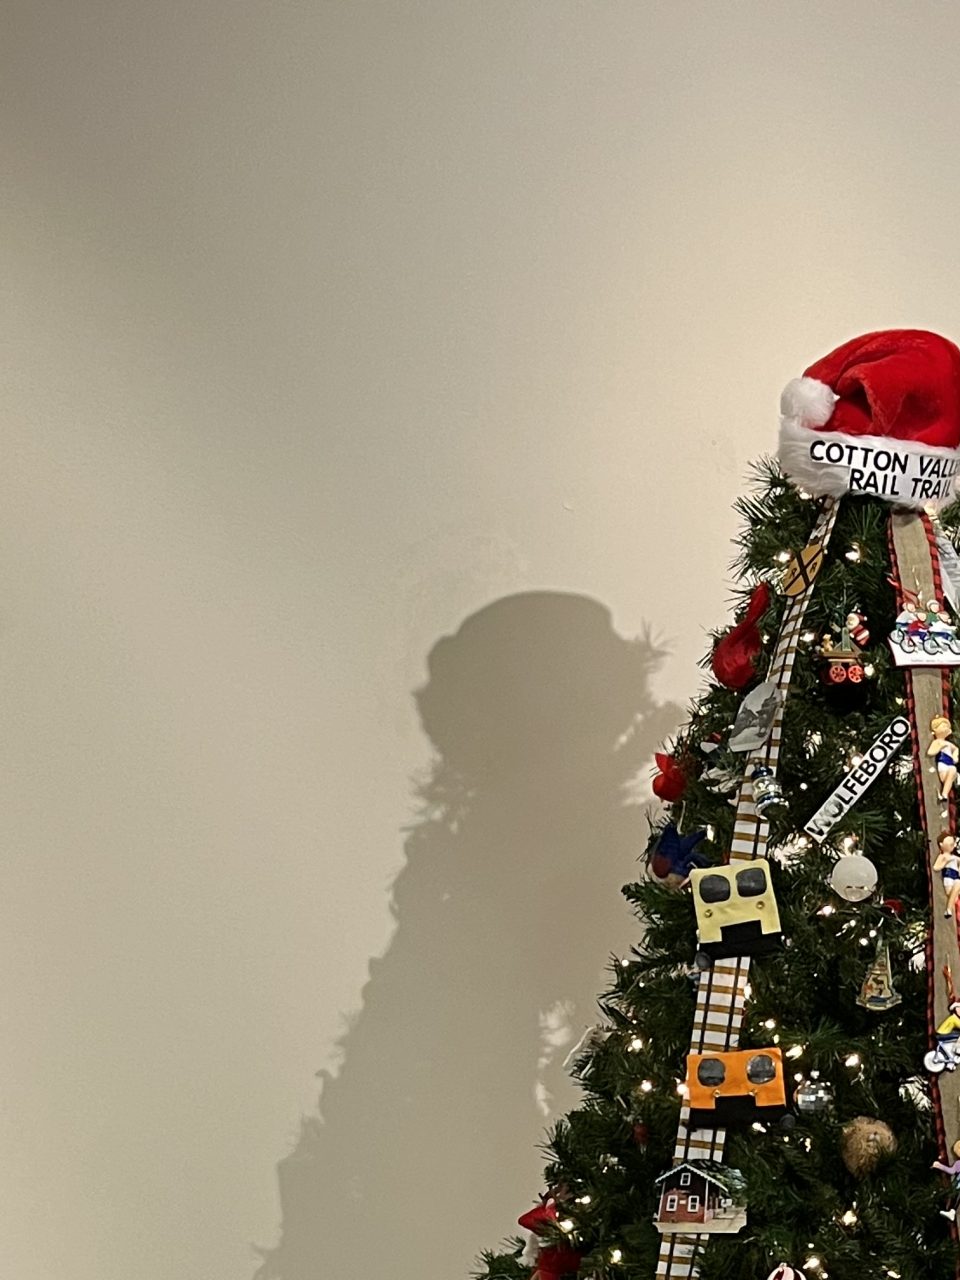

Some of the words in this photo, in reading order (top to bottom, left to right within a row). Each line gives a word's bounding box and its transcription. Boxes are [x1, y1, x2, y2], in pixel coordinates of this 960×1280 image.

[810, 440, 909, 474] COTTON
[850, 468, 900, 496] RAIL
[911, 478, 951, 499] TRAIL
[806, 719, 909, 837] WOLFEBORO
